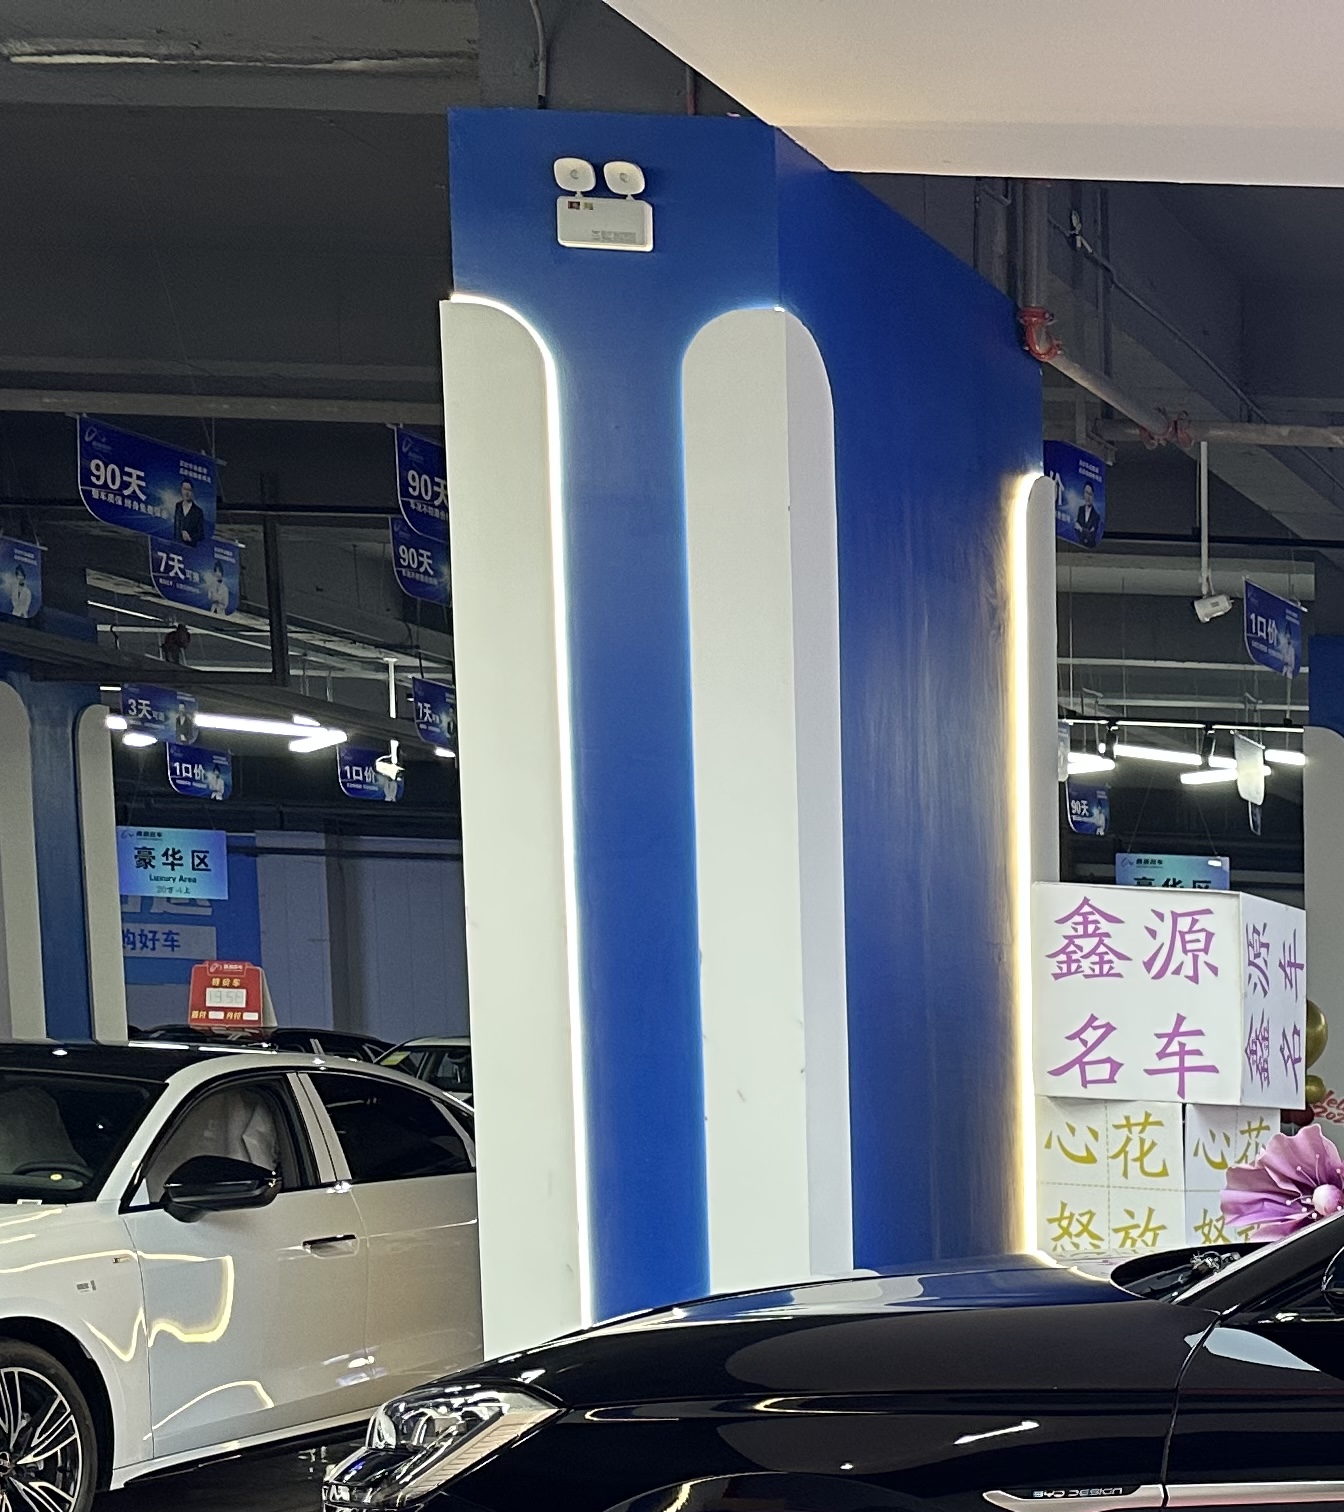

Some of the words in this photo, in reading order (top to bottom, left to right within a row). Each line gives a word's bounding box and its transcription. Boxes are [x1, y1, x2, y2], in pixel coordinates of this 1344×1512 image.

[90, 459, 147, 501] 90天
[407, 470, 449, 507] 90天
[398, 545, 434, 576] 90天
[1250, 612, 1278, 647] 1口价
[175, 762, 206, 782] 1口价
[344, 765, 376, 785] 1口价
[1071, 800, 1090, 817] 90天
[133, 846, 212, 872] 豪华区
[149, 874, 177, 884] Luxury
[178, 875, 198, 884] Area
[1045, 896, 1219, 985] 鑫源
[1047, 1013, 1219, 1100] 名车
[1044, 1110, 1170, 1180] 心花
[1067, 1487, 1123, 1497] DESIGN
